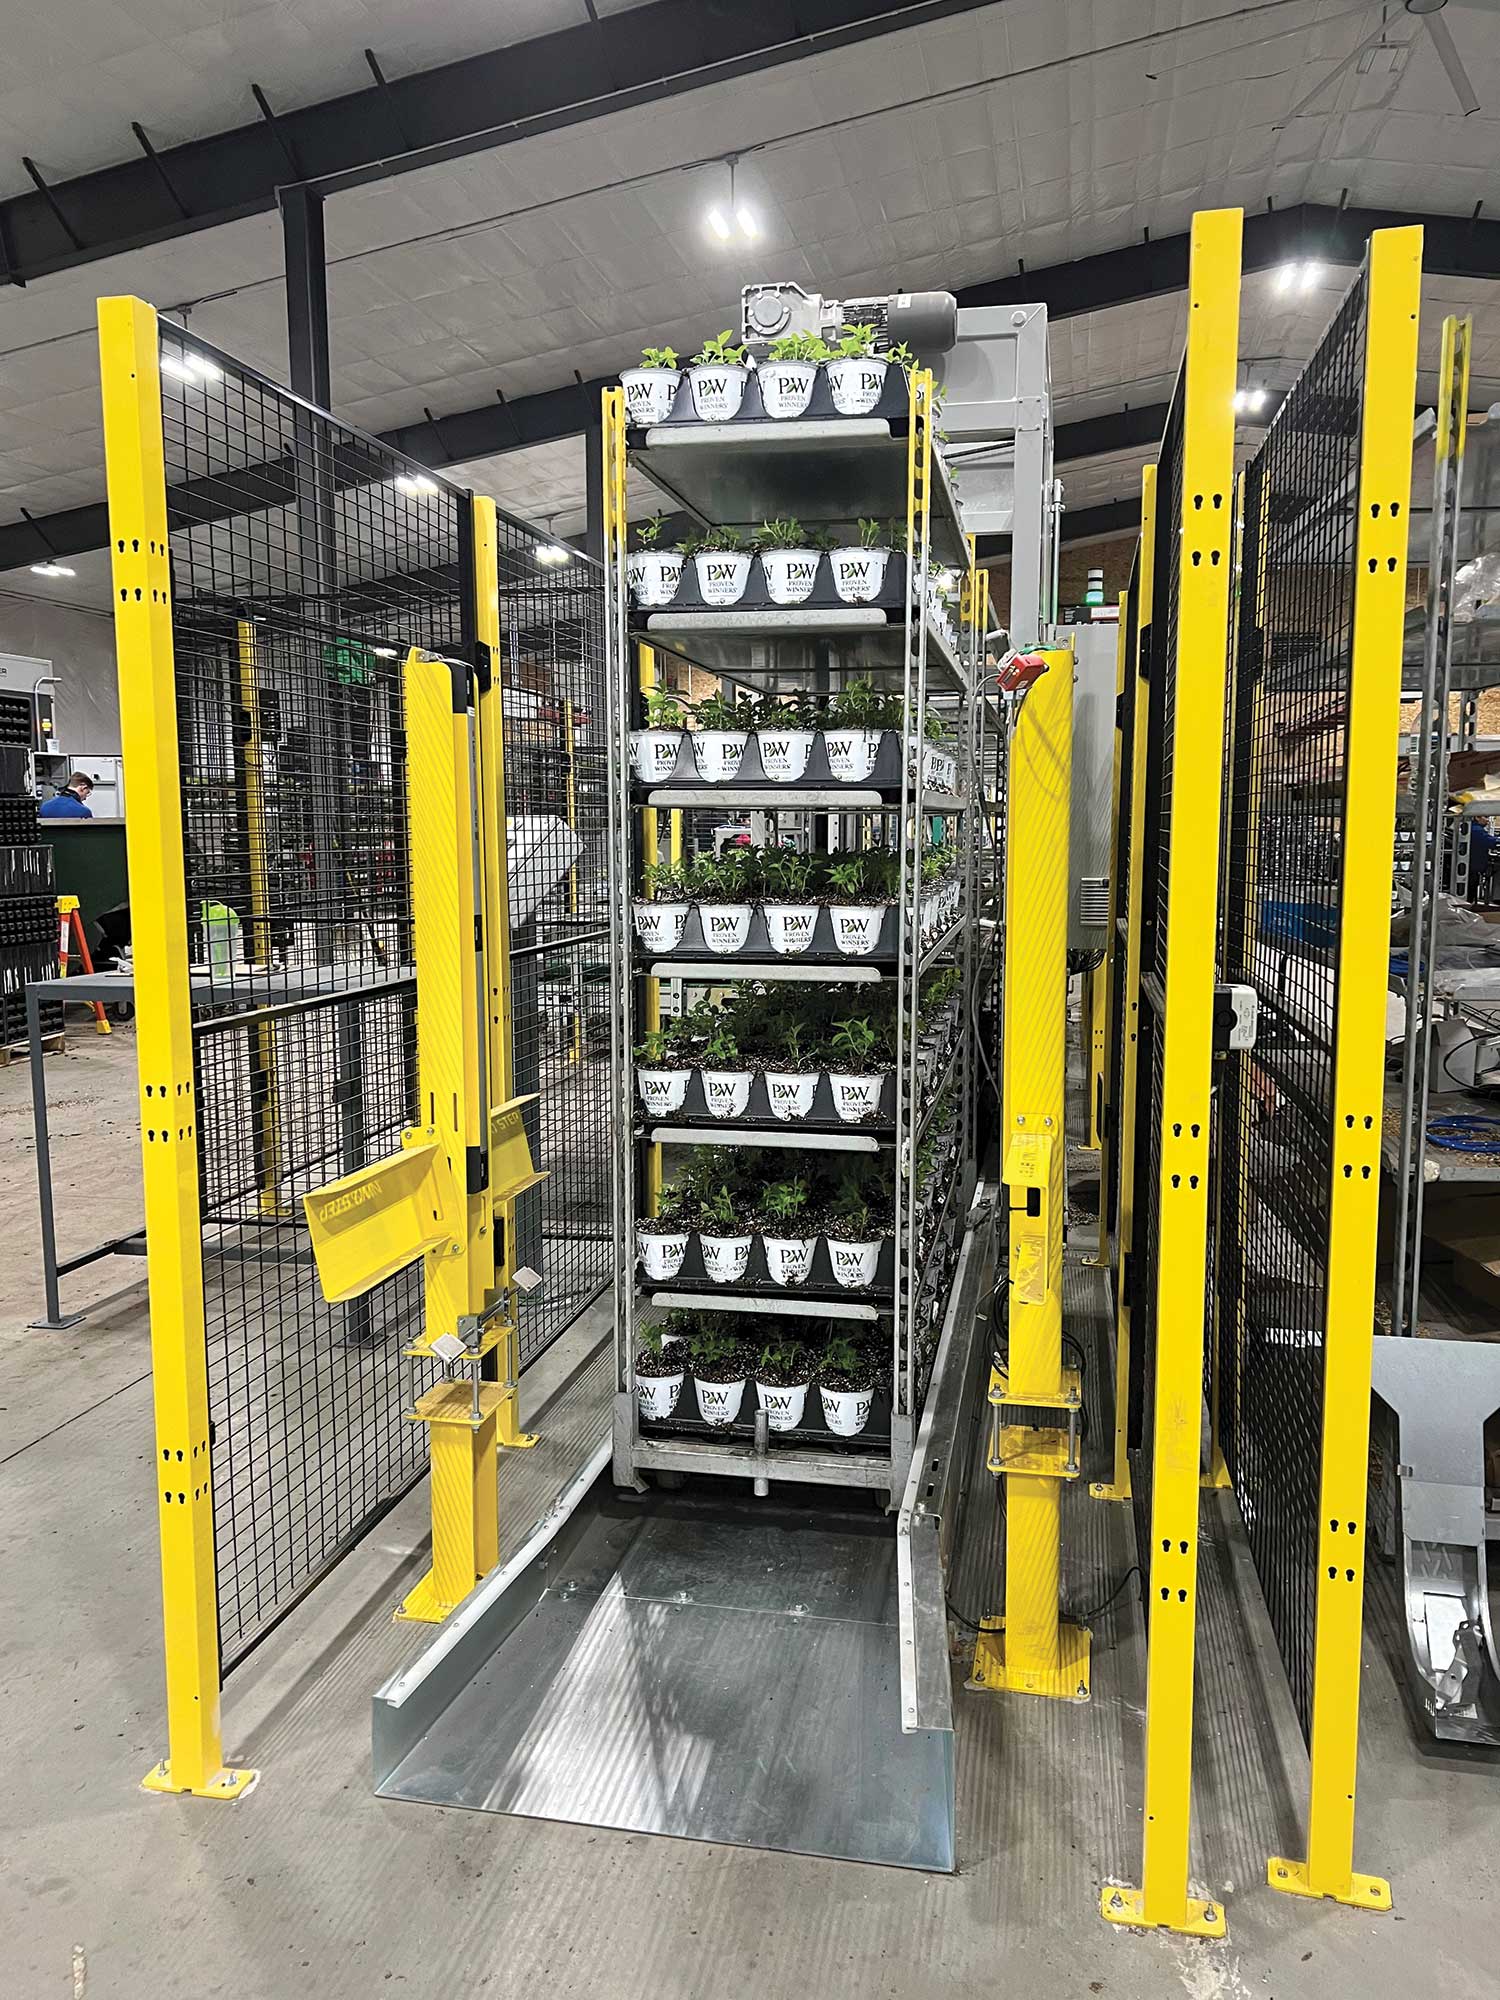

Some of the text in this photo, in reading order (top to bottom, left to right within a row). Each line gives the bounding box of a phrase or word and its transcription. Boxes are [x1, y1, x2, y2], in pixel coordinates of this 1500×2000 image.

[627, 383, 653, 402] PW
[698, 379, 727, 397] PW
[778, 378, 809, 394] PW
[706, 564, 737, 580] PW
[786, 563, 815, 579] PW
[840, 562, 870, 579] PW
[654, 743, 681, 759] PW
[763, 742, 790, 758] PW
[827, 741, 852, 757] PW
[637, 916, 661, 930] PW
[710, 917, 739, 931] PW
[783, 916, 812, 931] PW
[840, 919, 869, 933] PW
[644, 1081, 671, 1095] PW
[709, 1082, 736, 1096] PW
[772, 1084, 800, 1098] PW
[840, 1086, 870, 1100] PW
[780, 1248, 809, 1263] PW
[835, 1251, 864, 1266] PW
[701, 1390, 728, 1405] PW
[764, 1394, 792, 1409] PW
